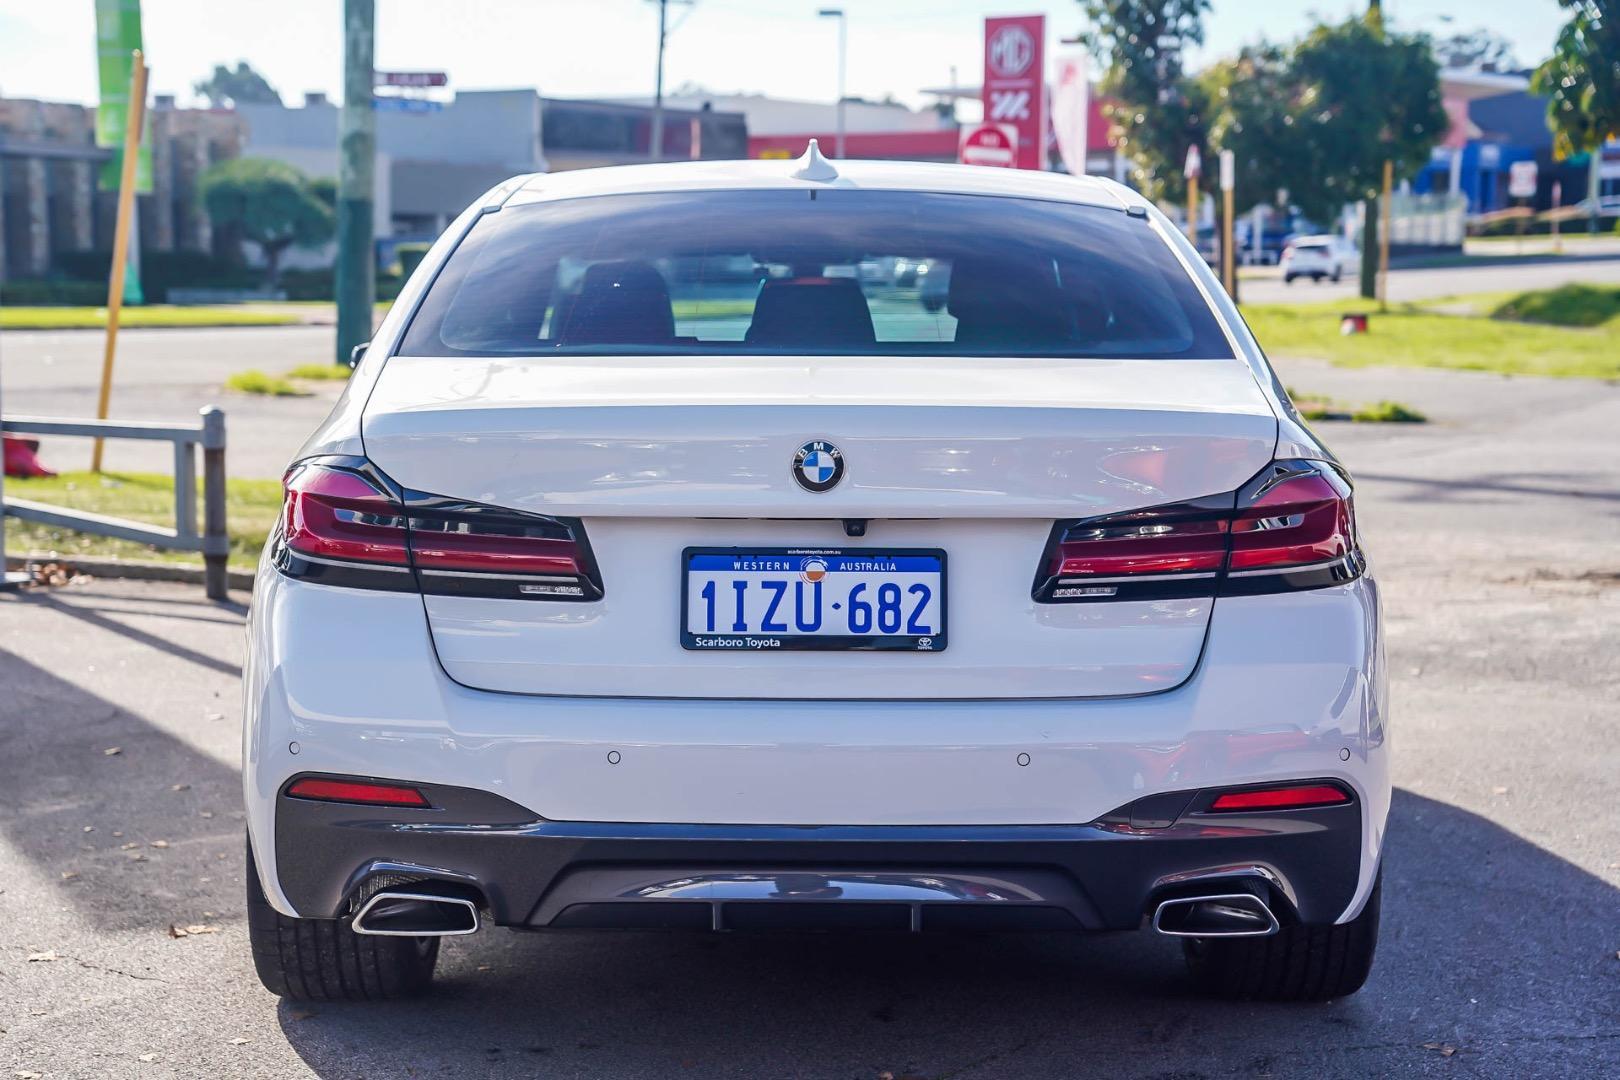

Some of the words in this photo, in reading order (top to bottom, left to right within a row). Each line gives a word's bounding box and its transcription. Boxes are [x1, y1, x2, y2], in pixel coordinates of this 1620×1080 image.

[798, 442, 840, 458] BMW
[733, 561, 790, 571] WESTERN
[839, 562, 898, 571] AUSTRALIA
[695, 637, 743, 647] Scarboro
[745, 637, 781, 649] Toyota
